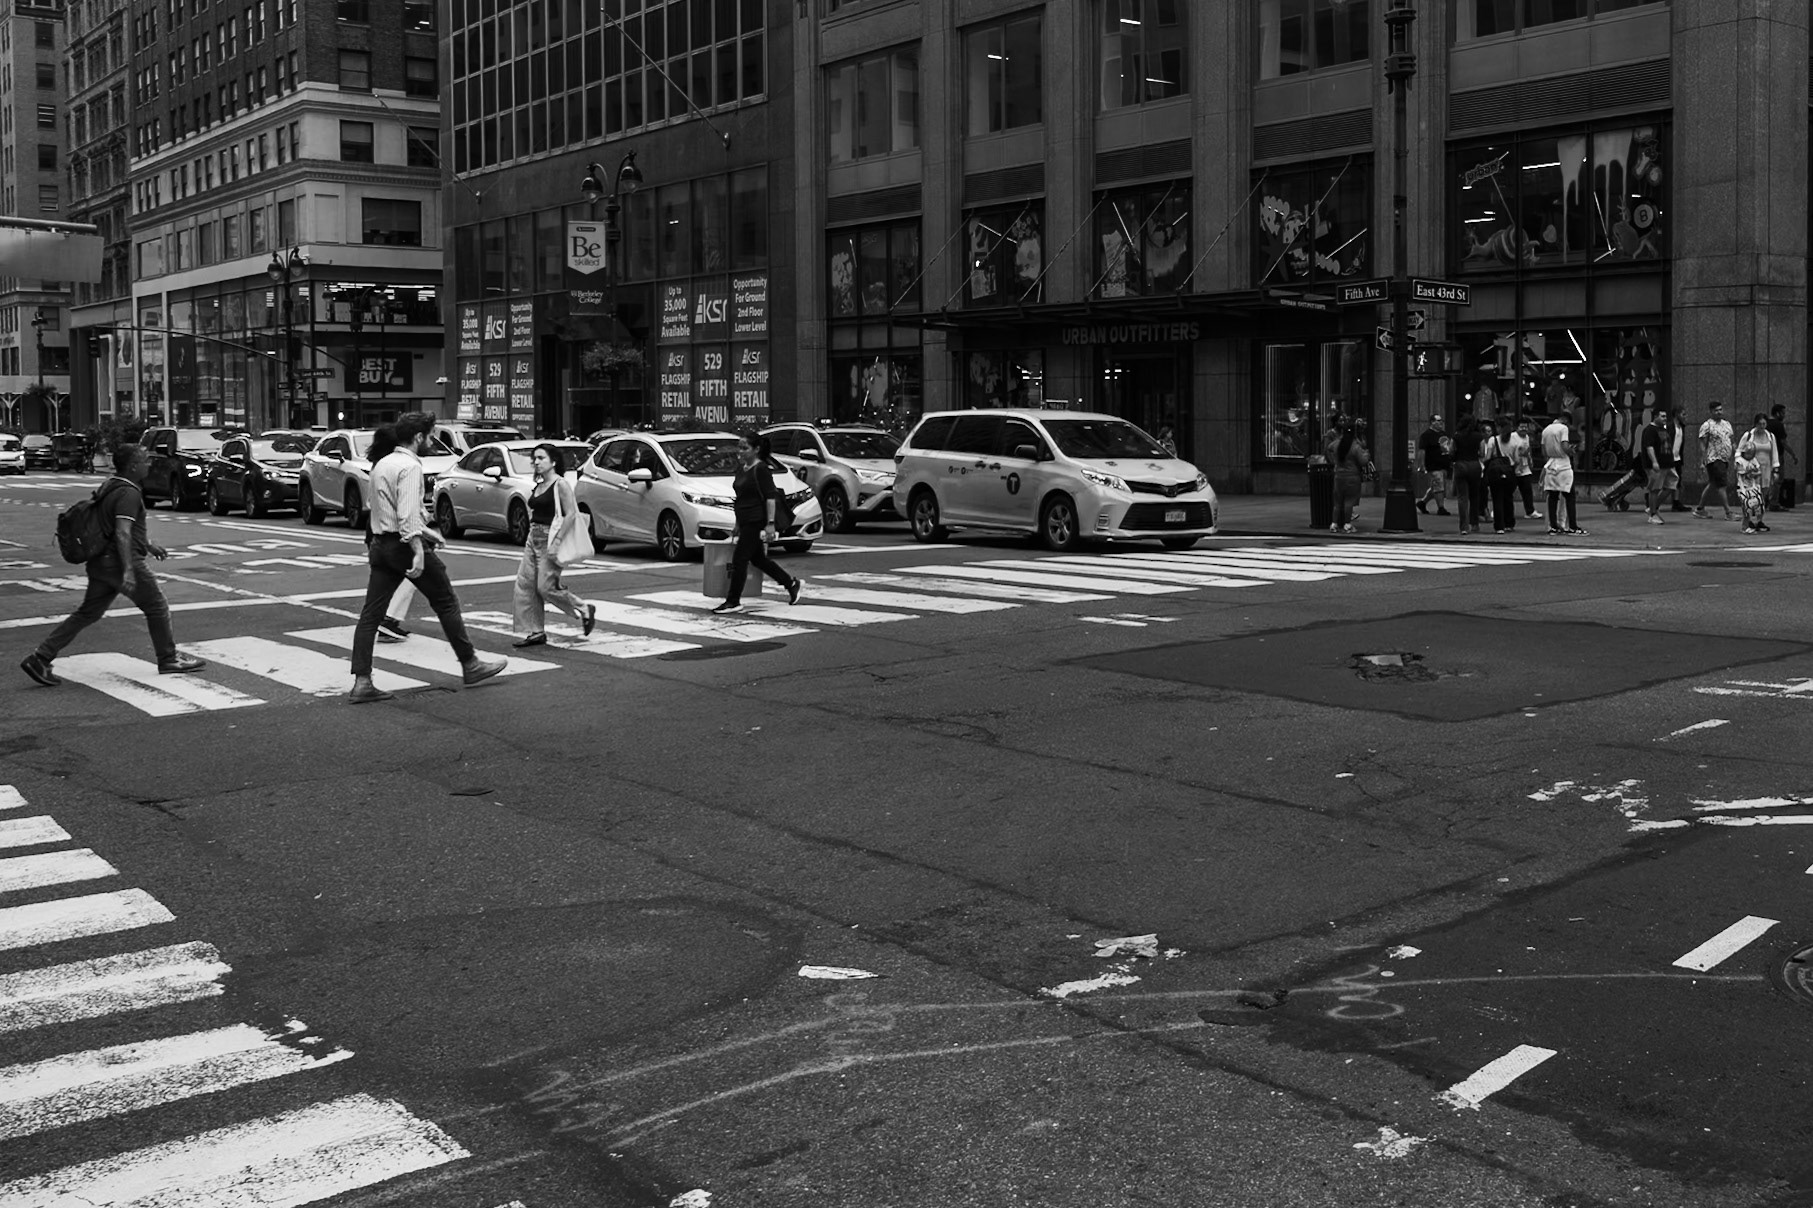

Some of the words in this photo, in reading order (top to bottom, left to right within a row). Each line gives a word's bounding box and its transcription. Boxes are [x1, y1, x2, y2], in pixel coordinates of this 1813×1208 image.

[570, 236, 602, 258] Be
[733, 277, 768, 291] Opportunity
[577, 290, 604, 298] Berkeley
[668, 286, 676, 297] Up
[676, 286, 682, 294] to
[735, 293, 744, 303] For
[745, 290, 766, 302] Ground
[1345, 287, 1364, 300] Fifth
[1365, 286, 1380, 298] Ave
[1417, 284, 1435, 295] East
[1437, 287, 1455, 299] 43rd
[1456, 288, 1466, 301] St
[664, 298, 687, 312] 35,000
[737, 307, 749, 318] 2nd
[749, 306, 764, 317] Floor
[663, 315, 678, 324] Square
[678, 313, 689, 322] Feet
[661, 324, 691, 338] Available
[735, 322, 751, 332] Lower
[751, 320, 767, 332] Level
[1062, 326, 1107, 345] URBAN
[1109, 321, 1200, 343] OUTFITTERS
[704, 353, 723, 370] 529
[489, 362, 502, 376] 529
[360, 370, 394, 384] BUY
[661, 373, 691, 385] FLAGSHIP
[734, 371, 769, 384] FLAGSHIP
[486, 383, 505, 398] FIFTH
[699, 379, 728, 397] FIFTH
[511, 394, 535, 409] RETAIL
[661, 391, 691, 408] RETAIL
[734, 390, 769, 408] RETAIL
